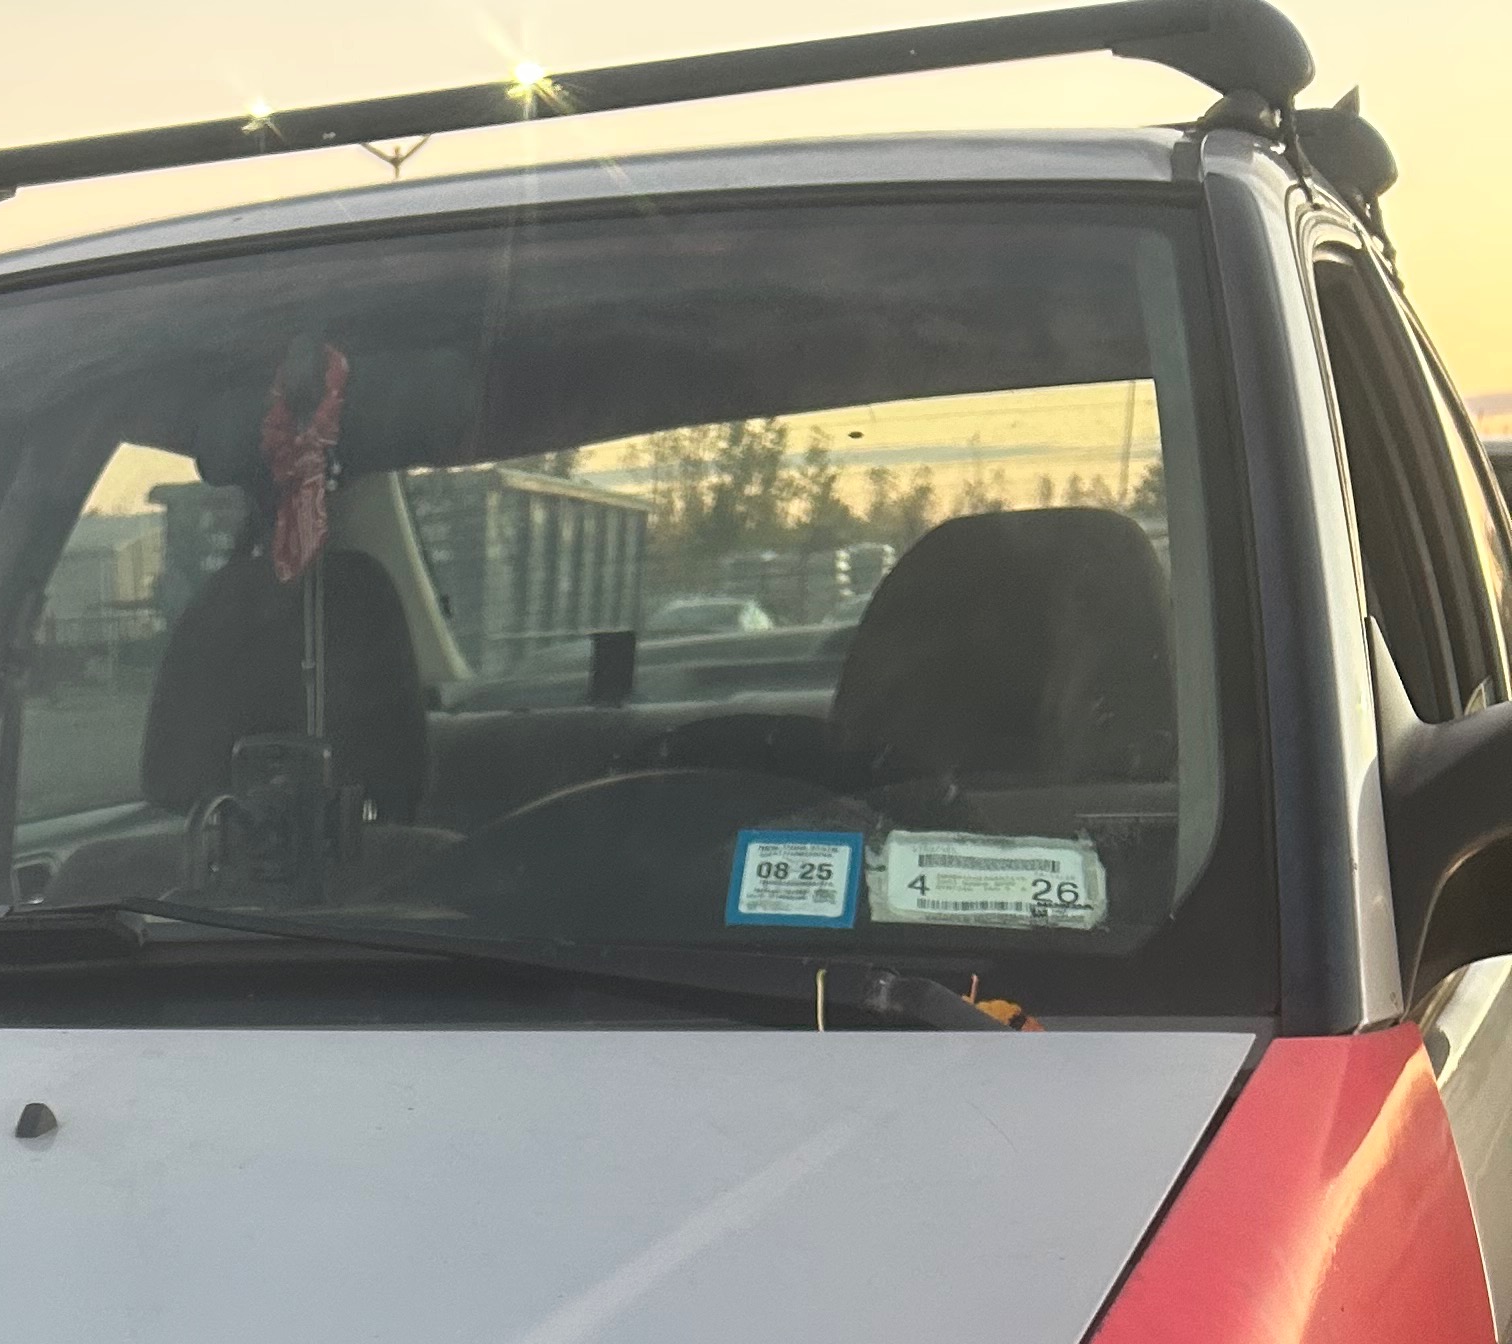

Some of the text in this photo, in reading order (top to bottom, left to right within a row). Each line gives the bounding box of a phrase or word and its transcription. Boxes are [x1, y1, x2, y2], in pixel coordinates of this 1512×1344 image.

[756, 861, 834, 881] 08 25
[907, 874, 931, 897] 4
[1031, 878, 1080, 905] 26
